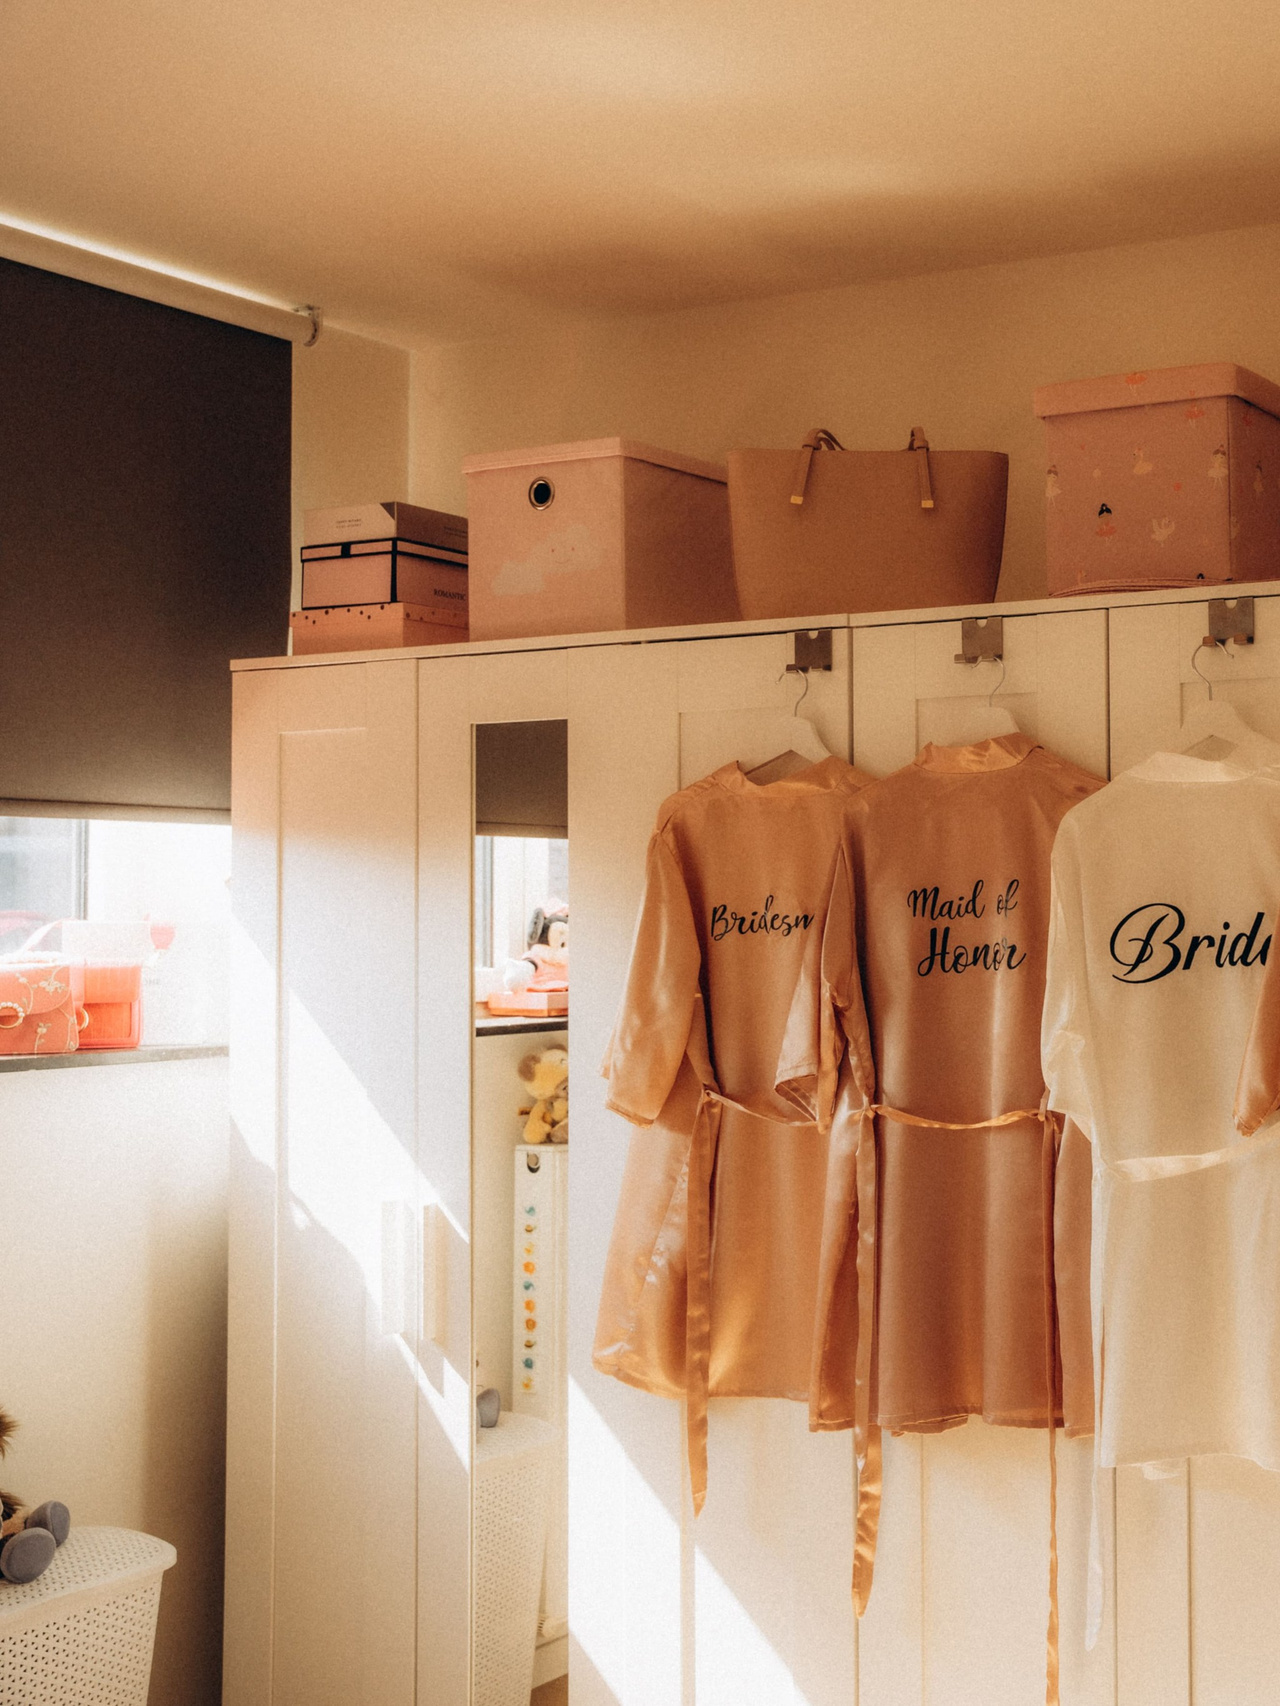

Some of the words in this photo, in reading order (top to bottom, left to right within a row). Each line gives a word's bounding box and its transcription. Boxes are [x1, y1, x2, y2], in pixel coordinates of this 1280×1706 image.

[907, 879, 985, 921] Maid
[996, 879, 1020, 918] of
[917, 926, 1027, 977] Honor
